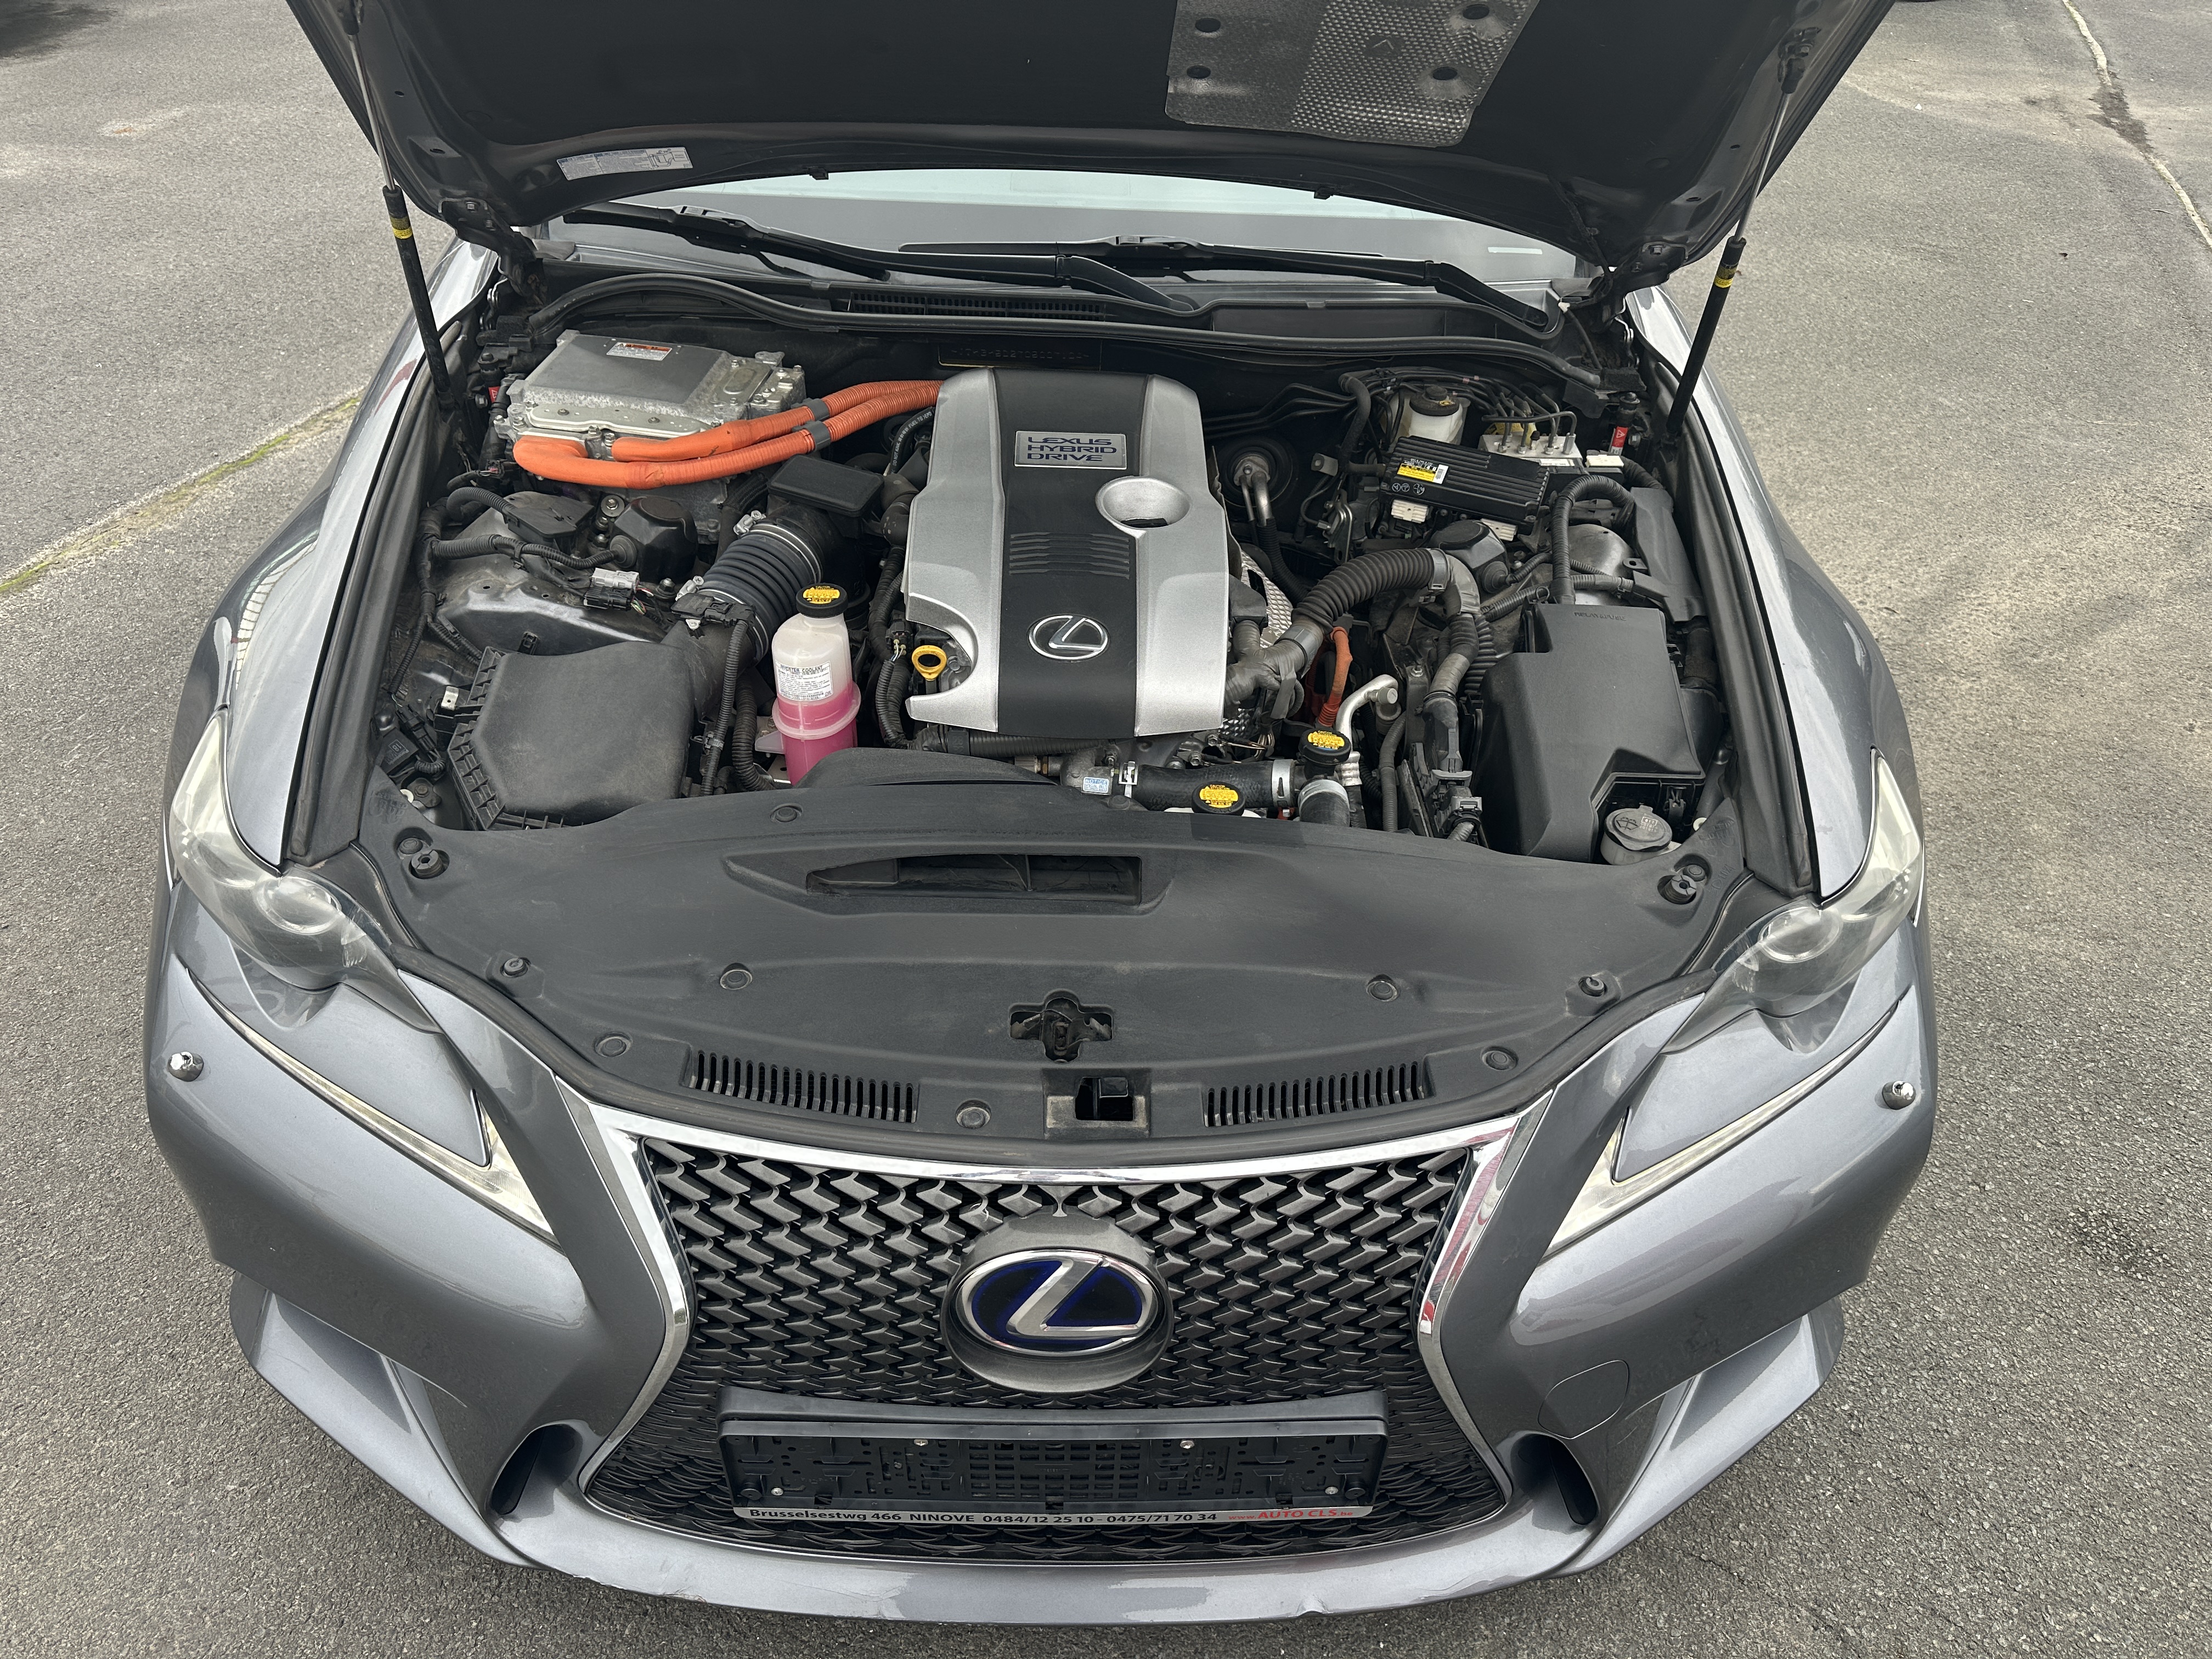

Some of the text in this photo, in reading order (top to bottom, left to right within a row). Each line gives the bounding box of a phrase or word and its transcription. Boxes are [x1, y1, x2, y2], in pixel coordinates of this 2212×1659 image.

[1028, 437, 1112, 445] LEXUS
[1028, 444, 1117, 454] HYBRID
[1027, 453, 1103, 461] DRIVE
[392, 743, 402, 752] 18
[749, 1509, 867, 1521] Brusselsestwg
[910, 1514, 975, 1522] NINOVE
[983, 1515, 1048, 1523] 0484/12
[1107, 1514, 1169, 1523] 0475/71
